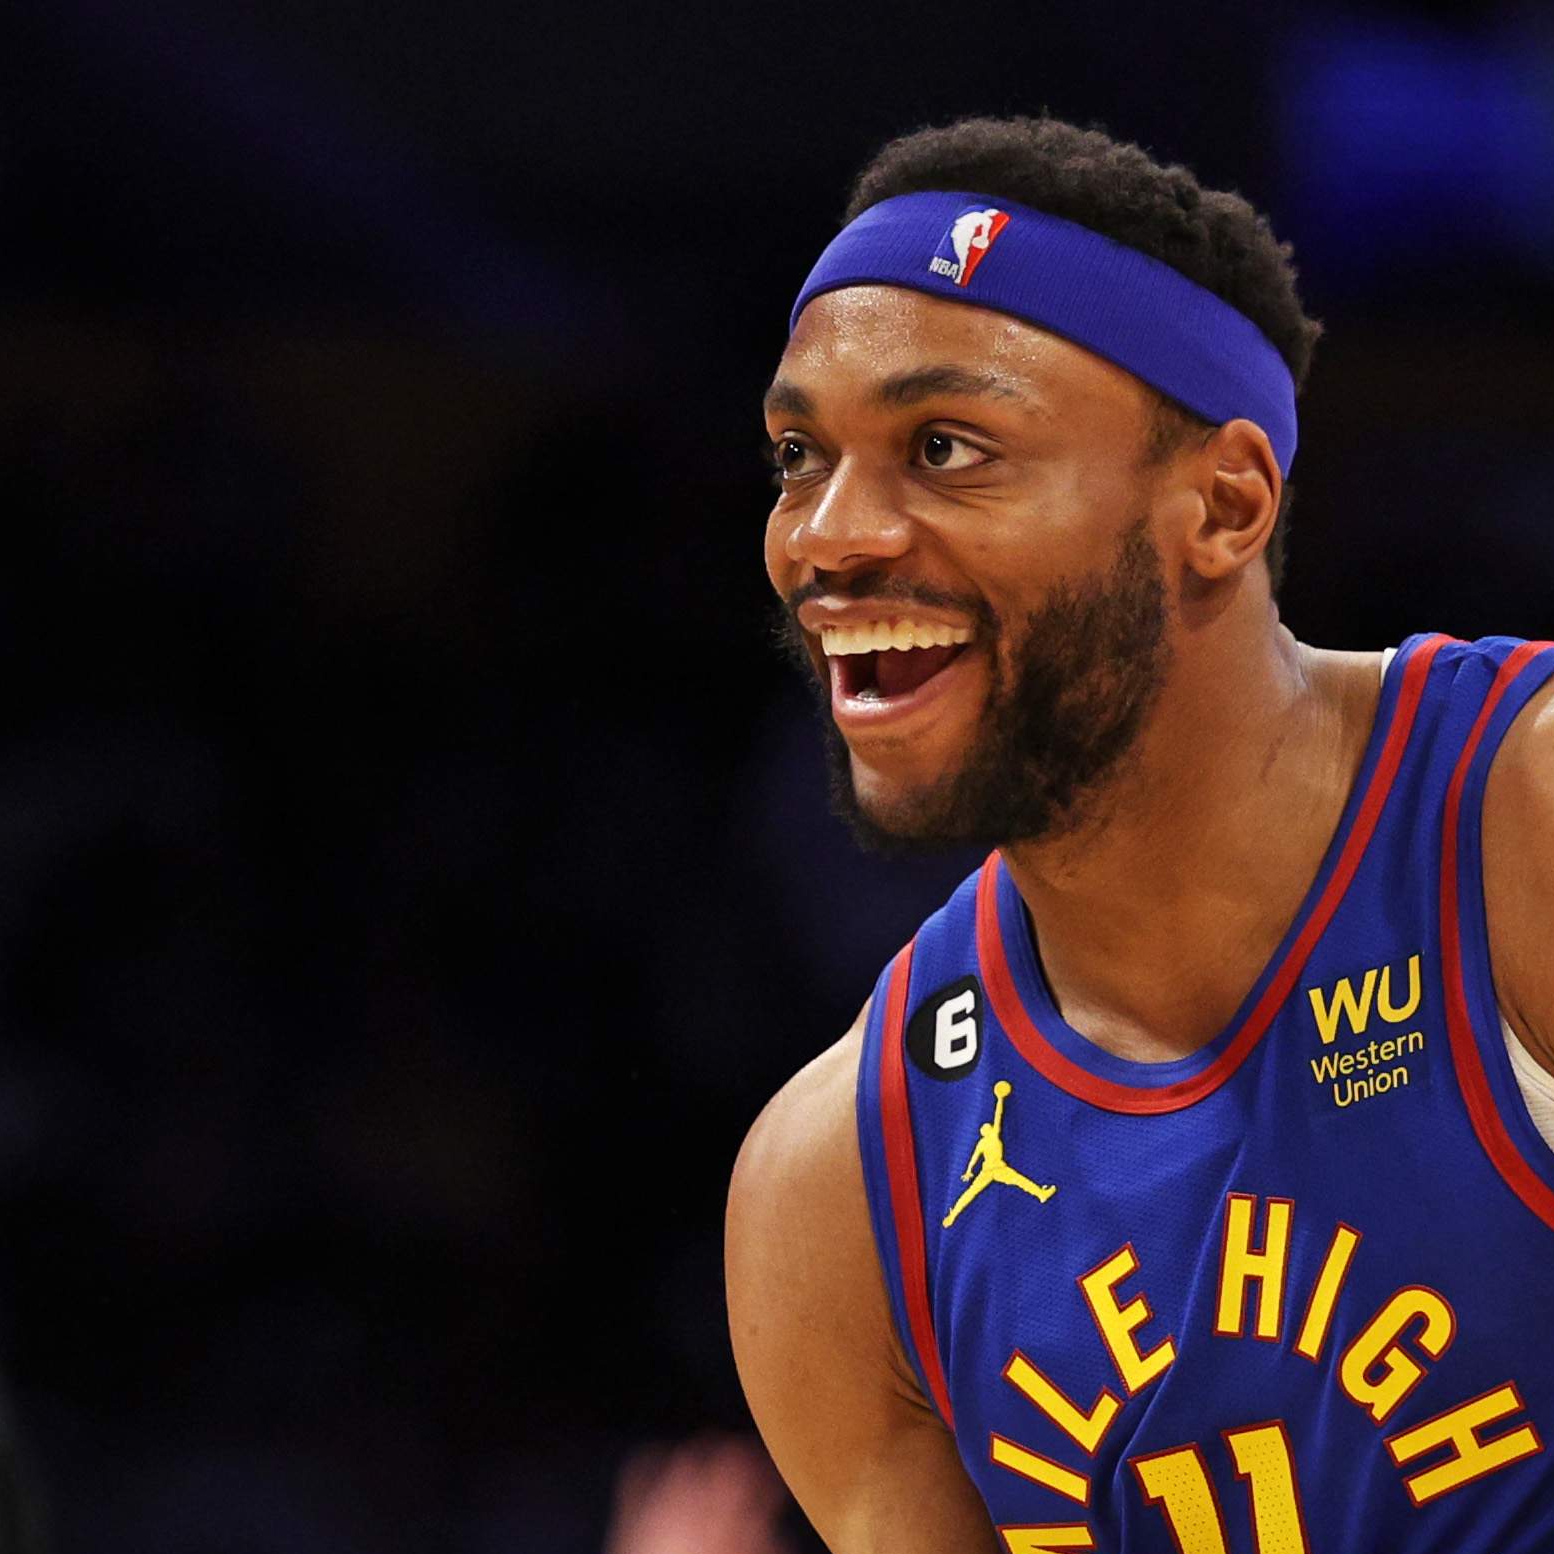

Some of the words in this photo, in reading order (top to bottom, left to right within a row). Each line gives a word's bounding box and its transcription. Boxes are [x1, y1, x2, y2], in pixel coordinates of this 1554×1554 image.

[929, 256, 959, 278] NBA
[933, 988, 978, 1070] 6
[1308, 953, 1422, 1045] WU
[1310, 1031, 1424, 1084] Western
[1333, 1065, 1409, 1107] Union
[1213, 1190, 1545, 1508] HIGH
